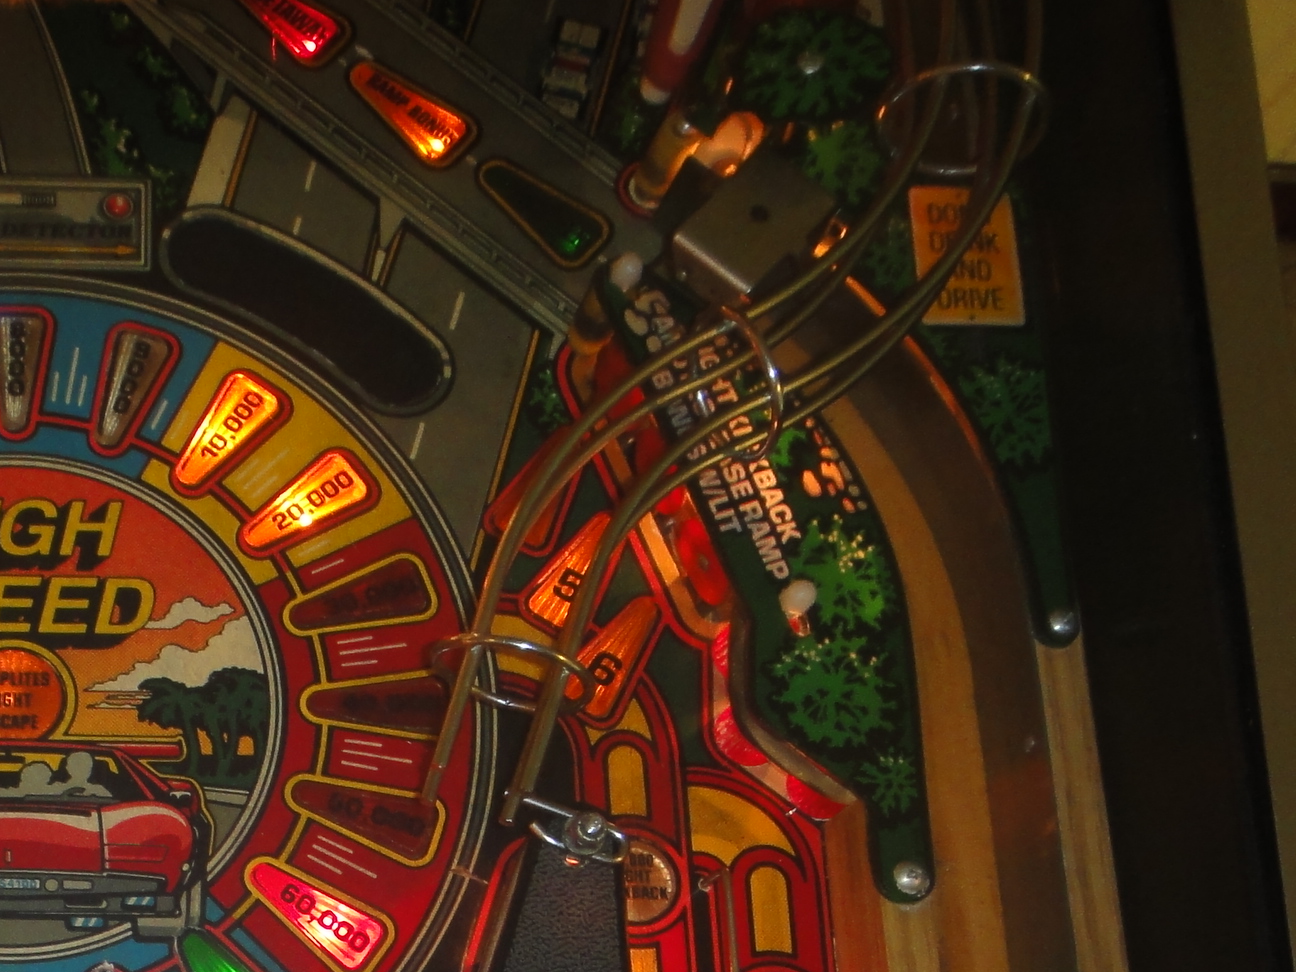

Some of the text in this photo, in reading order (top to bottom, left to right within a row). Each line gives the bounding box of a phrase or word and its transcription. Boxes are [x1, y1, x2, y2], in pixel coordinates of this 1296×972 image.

[3, 220, 134, 239] DETECTOR
[200, 390, 265, 458] 10,000
[271, 470, 355, 531] 20,000
[738, 499, 790, 580] RAMP
[553, 568, 585, 602] 5
[587, 652, 623, 686] 6
[280, 883, 371, 955] 60,000
